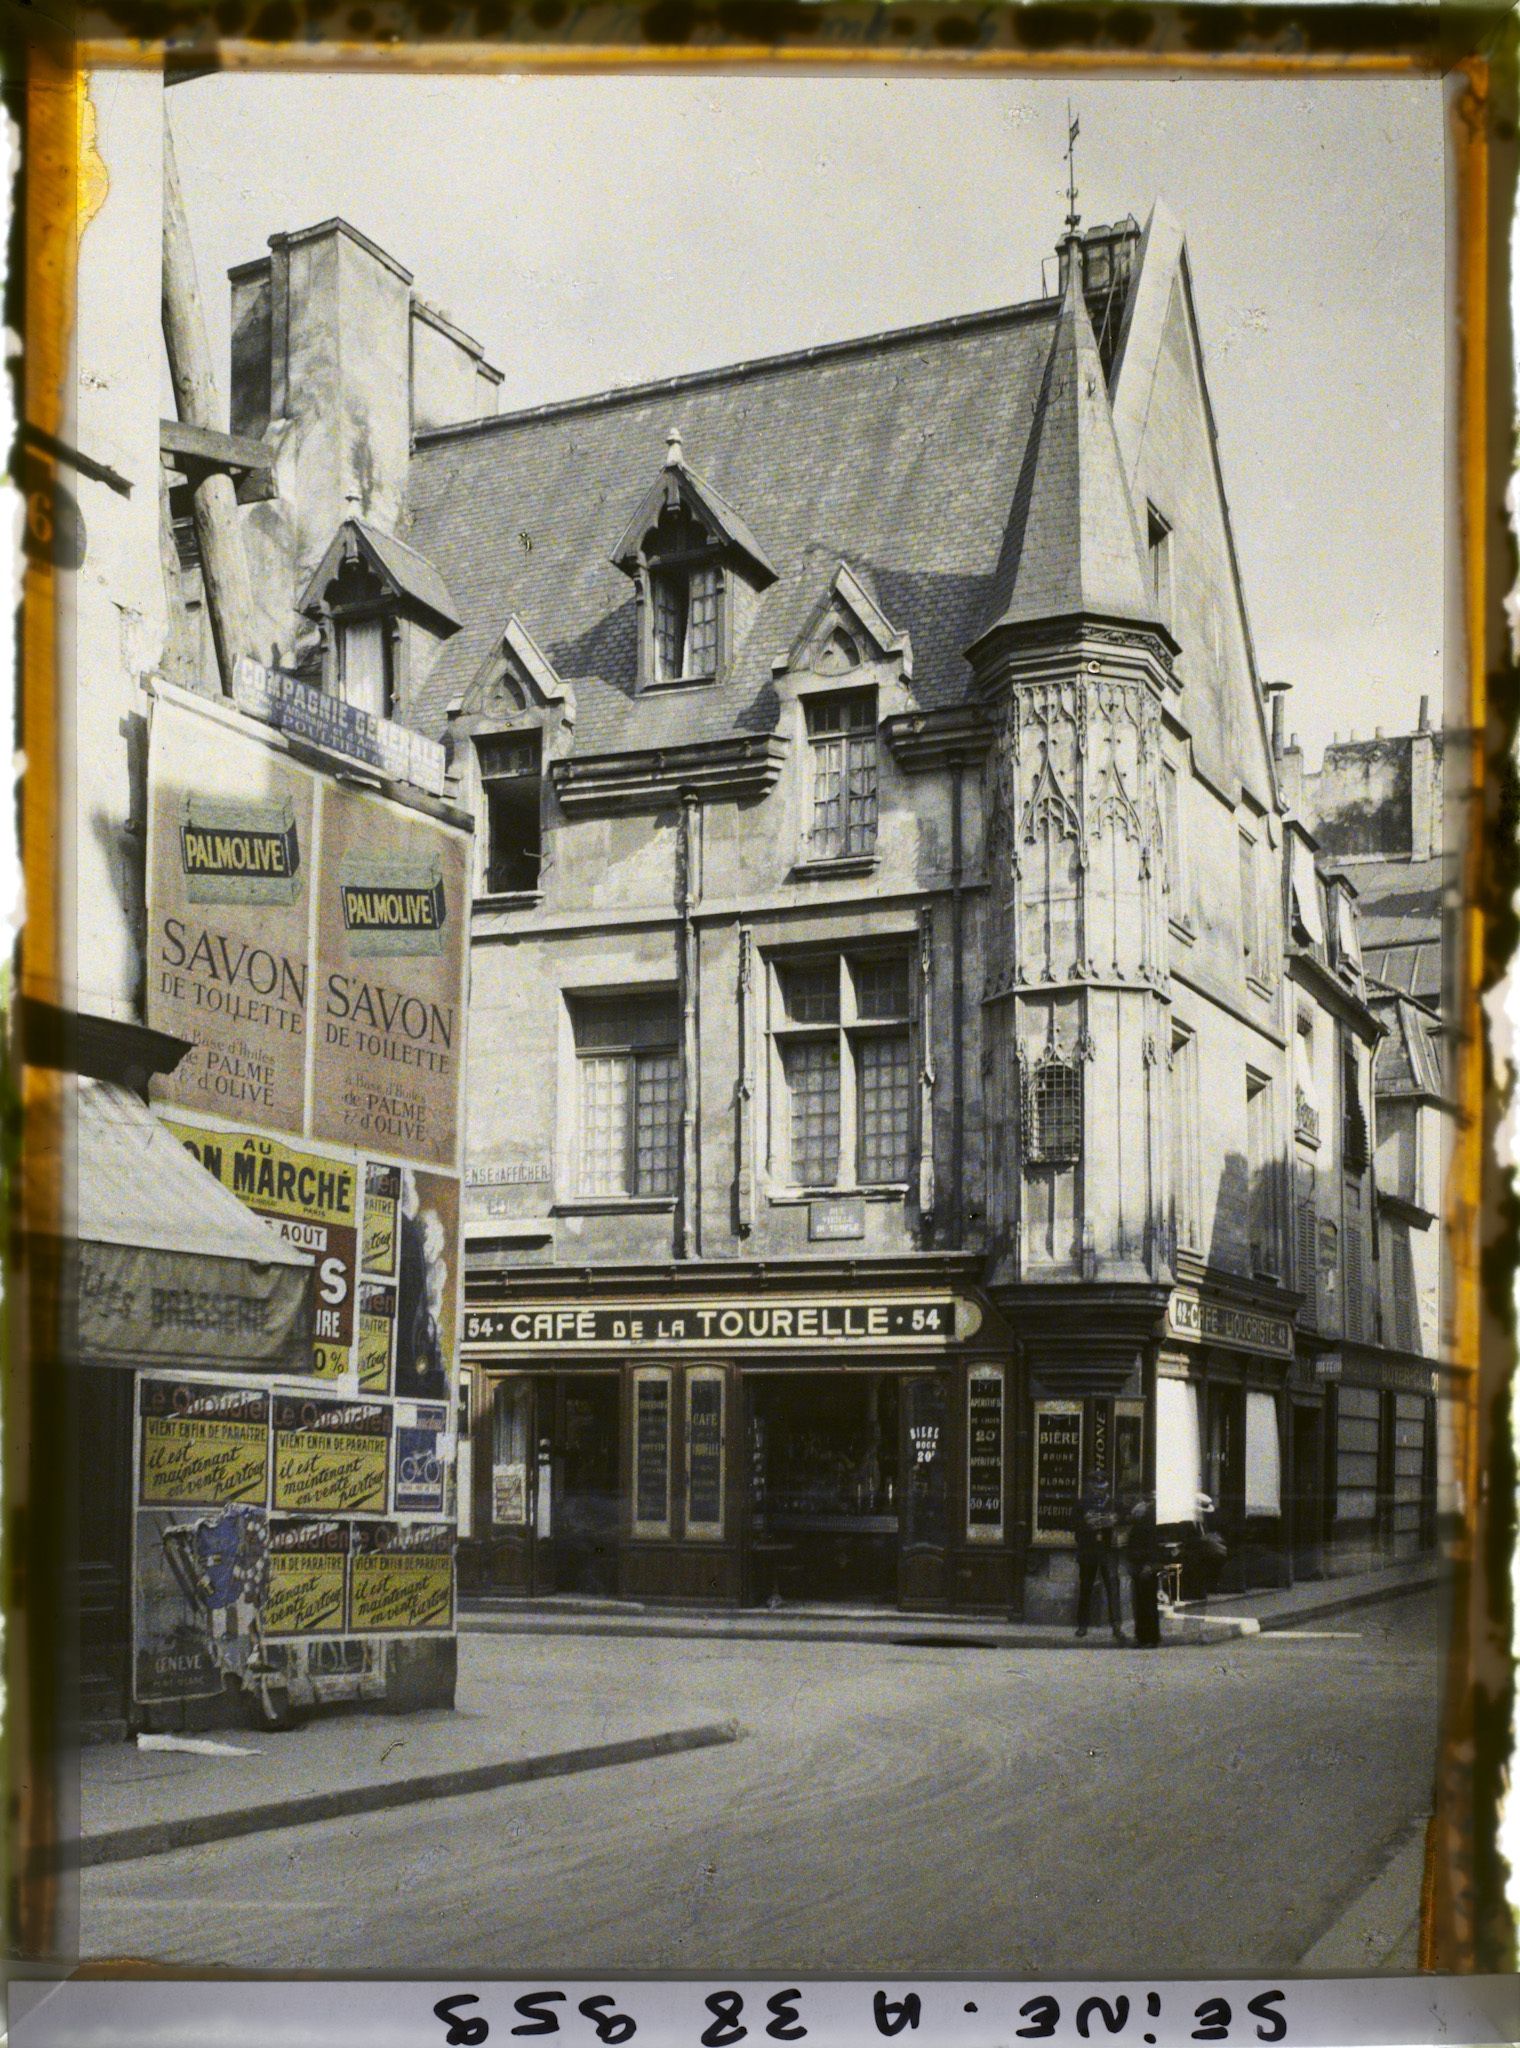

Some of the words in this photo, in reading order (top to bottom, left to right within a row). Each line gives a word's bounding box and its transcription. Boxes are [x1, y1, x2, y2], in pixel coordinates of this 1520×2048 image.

[241, 660, 348, 728] COMPAGNIE
[186, 833, 284, 871] PALMOLIVE
[348, 894, 433, 925] PALMOLIVE
[162, 918, 308, 1008] SAVON
[161, 972, 186, 999] DE
[194, 980, 303, 1034] TOILETTE
[327, 974, 452, 1050] SAVON
[327, 1024, 350, 1048] DE
[357, 1032, 450, 1075] TOILETTE
[208, 1052, 275, 1087] PALME
[198, 1071, 275, 1107] d'OLIVE
[368, 1093, 426, 1124] PALME
[361, 1113, 426, 1142] d'OLIVE
[243, 1138, 272, 1155] AU
[233, 1151, 352, 1213] MARCHÉ
[468, 1318, 494, 1338] 54
[510, 1310, 596, 1340] CAFÉ
[613, 1320, 643, 1338] DE
[657, 1319, 685, 1338] LA
[696, 1307, 889, 1338] TOURELLE
[911, 1308, 941, 1331] 54
[148, 1421, 176, 1437] VIENT
[180, 1421, 206, 1438] ENFIN
[208, 1423, 220, 1439] DE
[279, 1434, 304, 1448] VIENT
[307, 1435, 331, 1449] ENFIN
[334, 1437, 344, 1450] DE
[910, 1425, 940, 1440] BIERE
[915, 1440, 937, 1450] BOCK
[1039, 1430, 1079, 1445] BIÈRE
[149, 1446, 165, 1469] il
[152, 1446, 243, 1487] maintenant
[279, 1458, 294, 1479] il
[295, 1453, 320, 1475] est
[283, 1455, 366, 1495] maintenant
[358, 1574, 432, 1616] maintenant
[701, 1987, 808, 2047] 38
[873, 1990, 921, 2036] A
